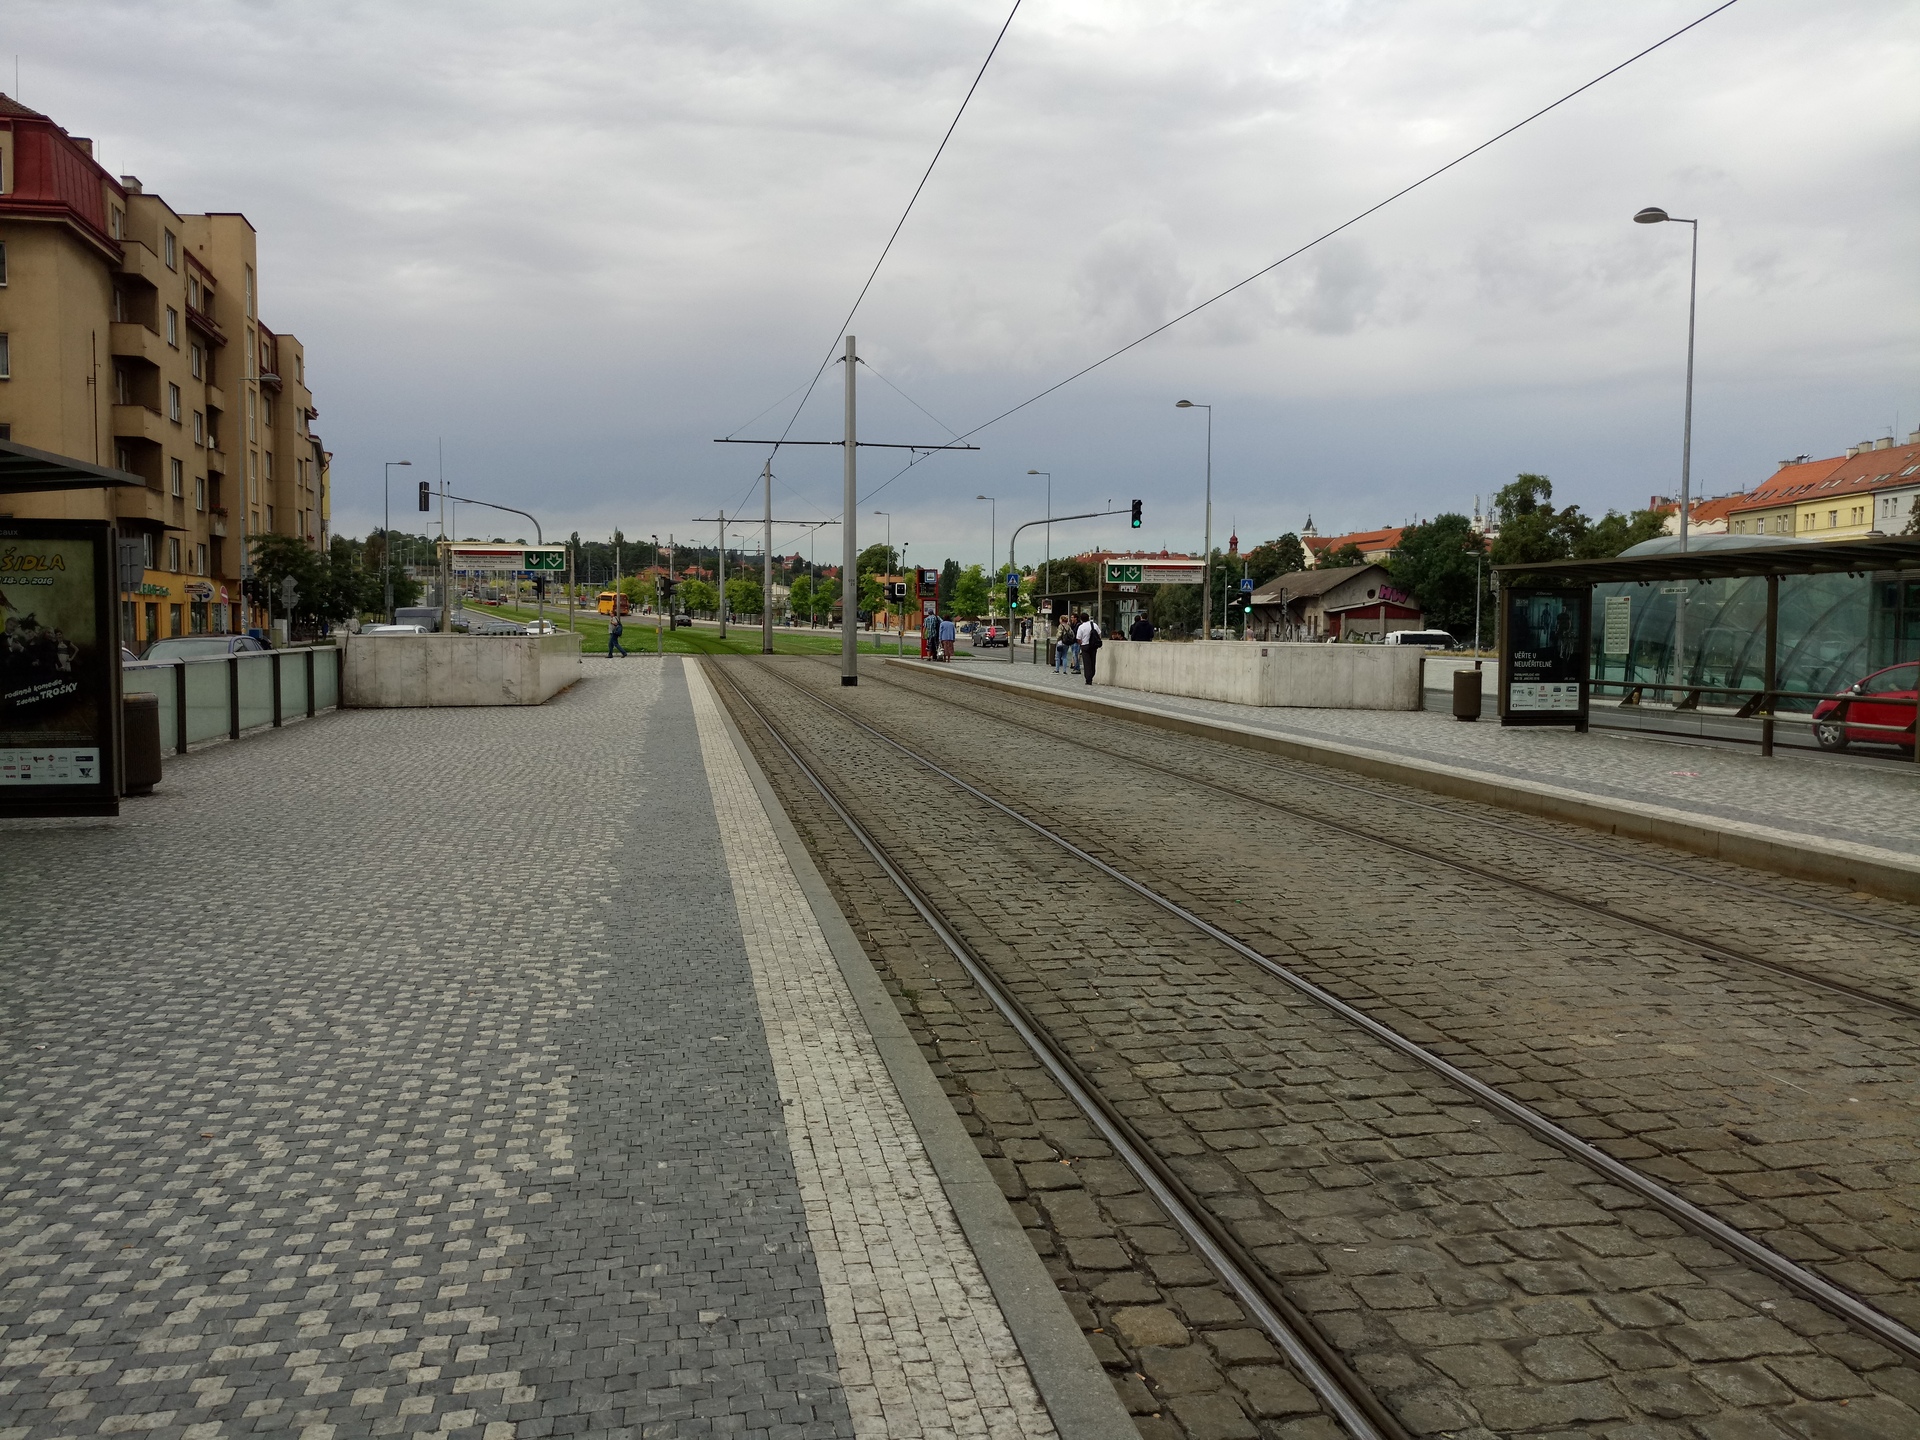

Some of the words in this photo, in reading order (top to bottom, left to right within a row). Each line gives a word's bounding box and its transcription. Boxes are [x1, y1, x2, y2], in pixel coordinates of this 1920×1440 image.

[0, 546, 66, 571] ŠIDLA
[31, 576, 54, 586] 2016
[1514, 651, 1532, 659] VĚŘTE
[40, 682, 78, 700] TROŠKY
